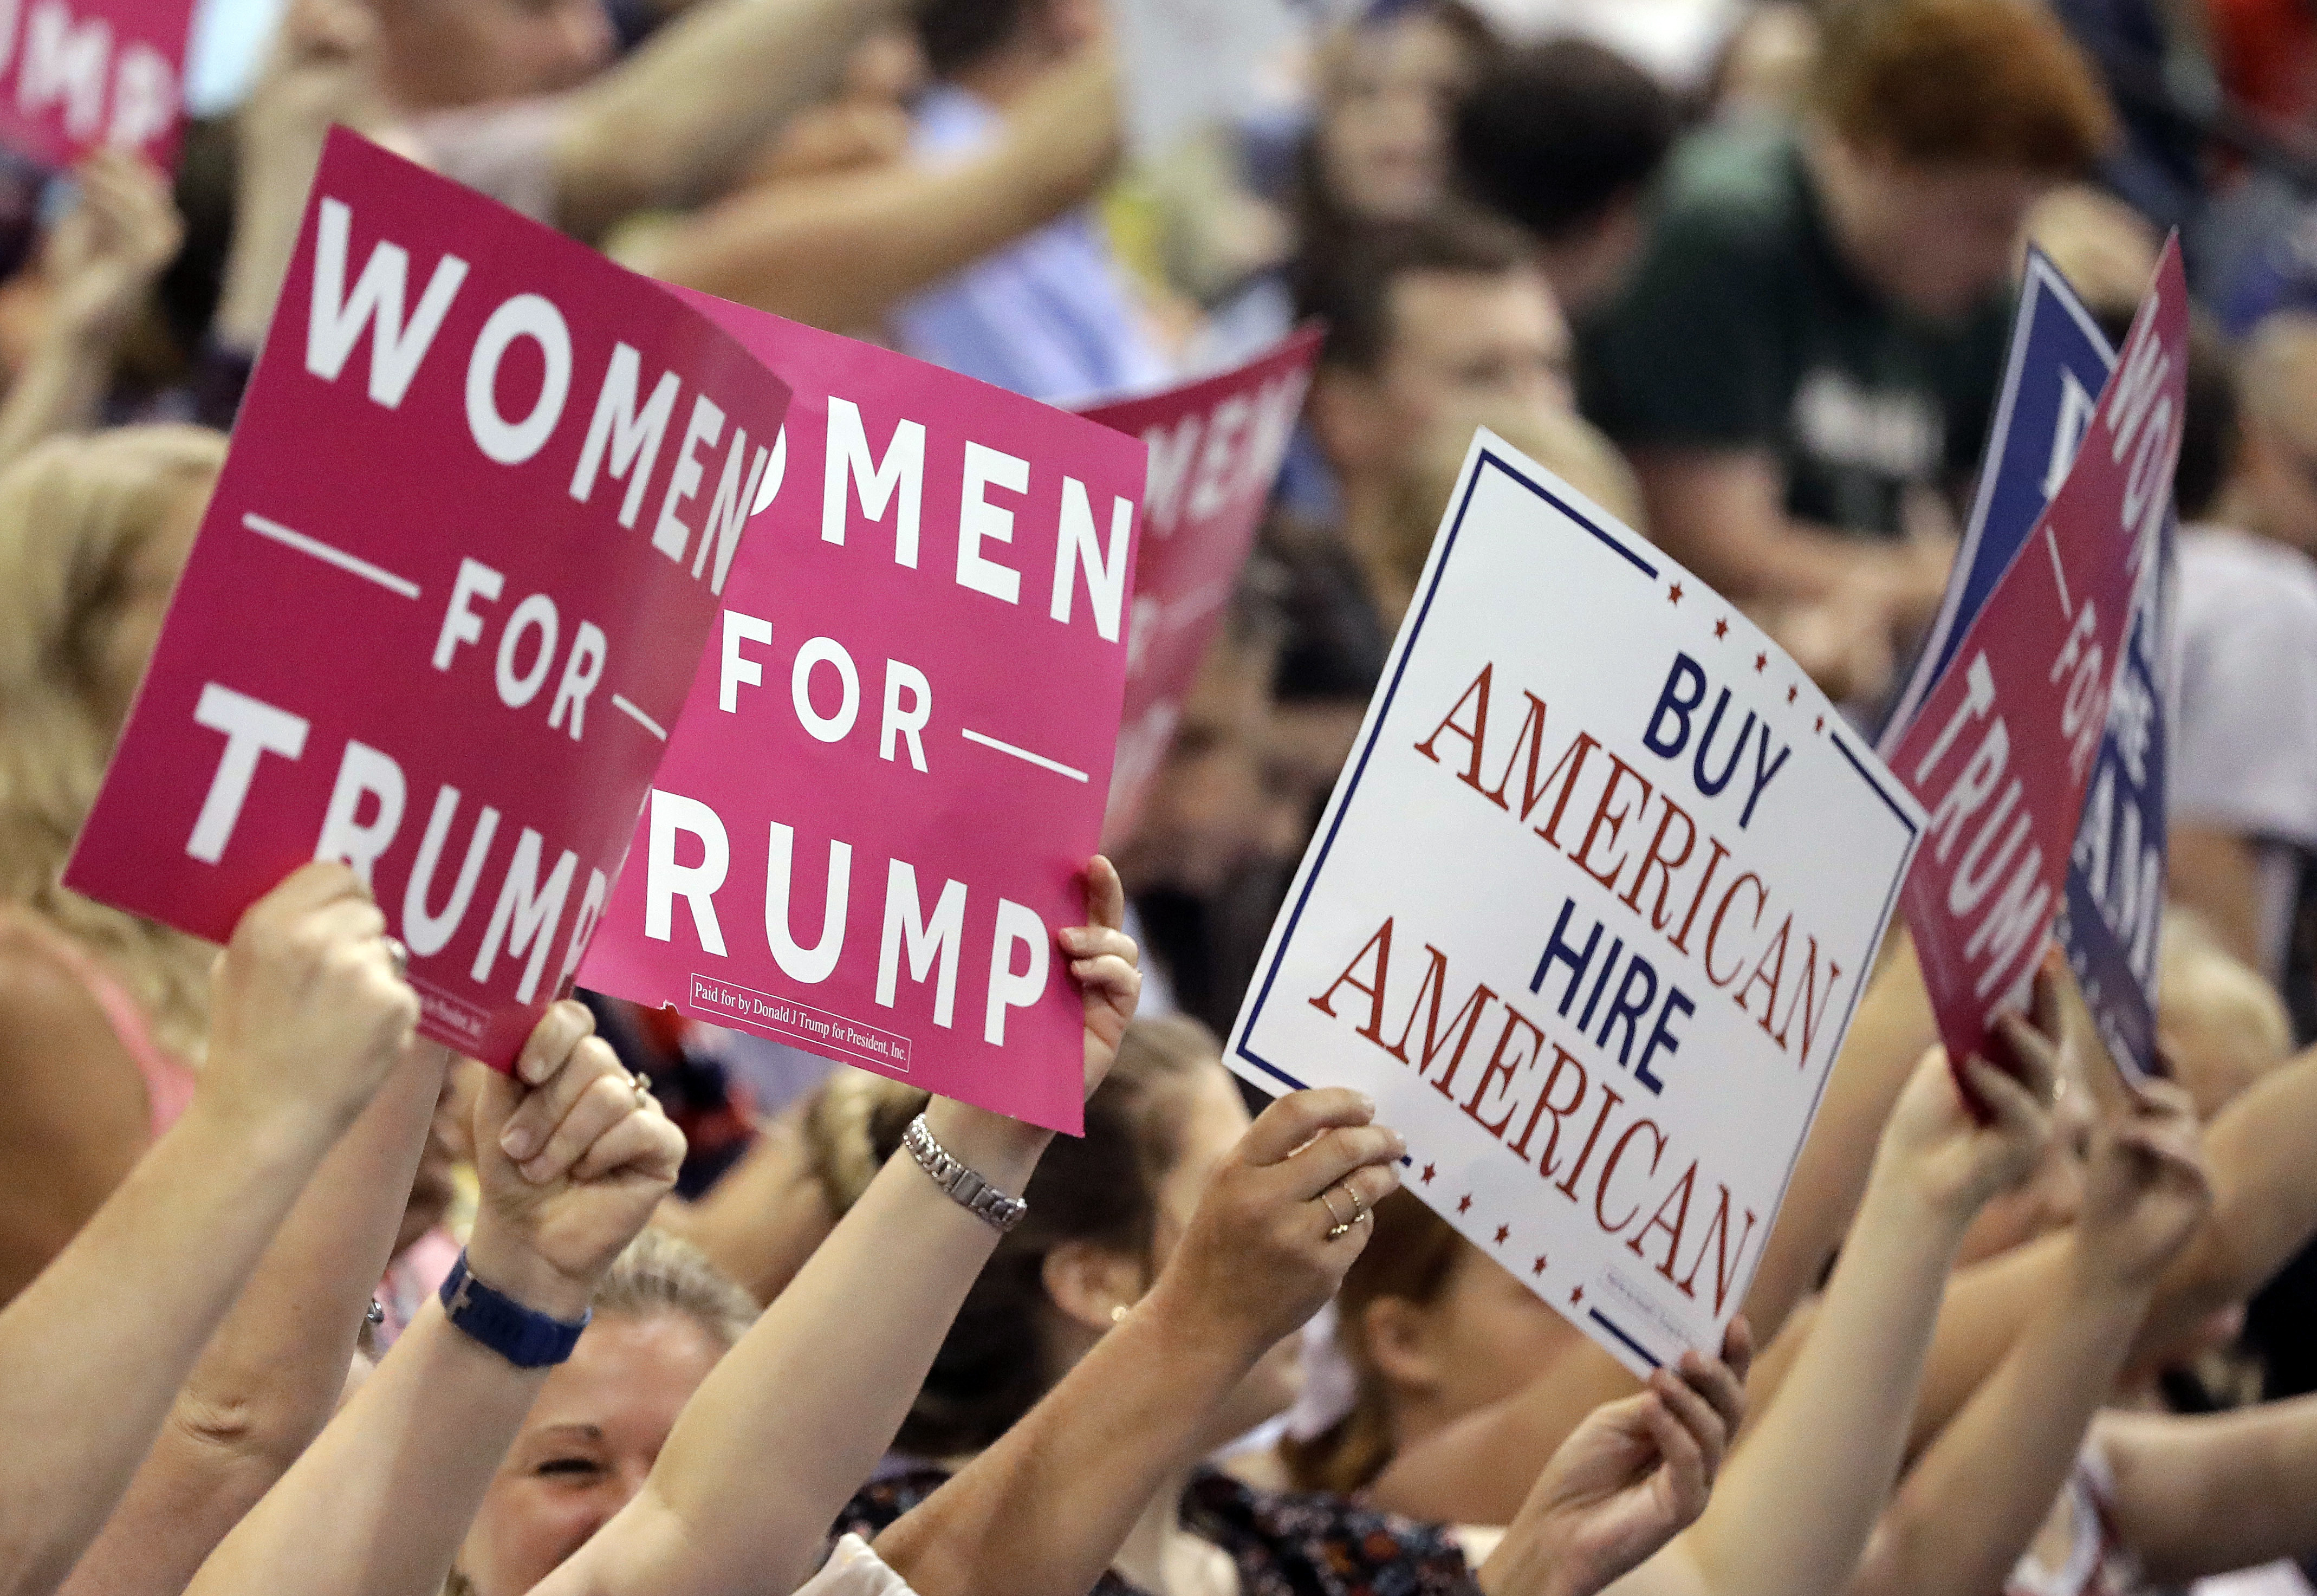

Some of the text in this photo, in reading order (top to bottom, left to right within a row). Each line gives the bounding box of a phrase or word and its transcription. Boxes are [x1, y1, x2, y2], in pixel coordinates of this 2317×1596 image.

[306, 196, 768, 597] WOMEN
[750, 394, 1134, 644] MEN
[432, 557, 608, 741] FOR
[718, 608, 932, 774] FOR
[1641, 651, 1791, 828] BUY
[1413, 661, 1841, 1069] AMERICAN
[695, 982, 907, 1061] Paid for by Donald J Trump for President, Inc.
[1529, 897, 1696, 1097] HIRE
[1308, 916, 1758, 1319] AMERICAN
